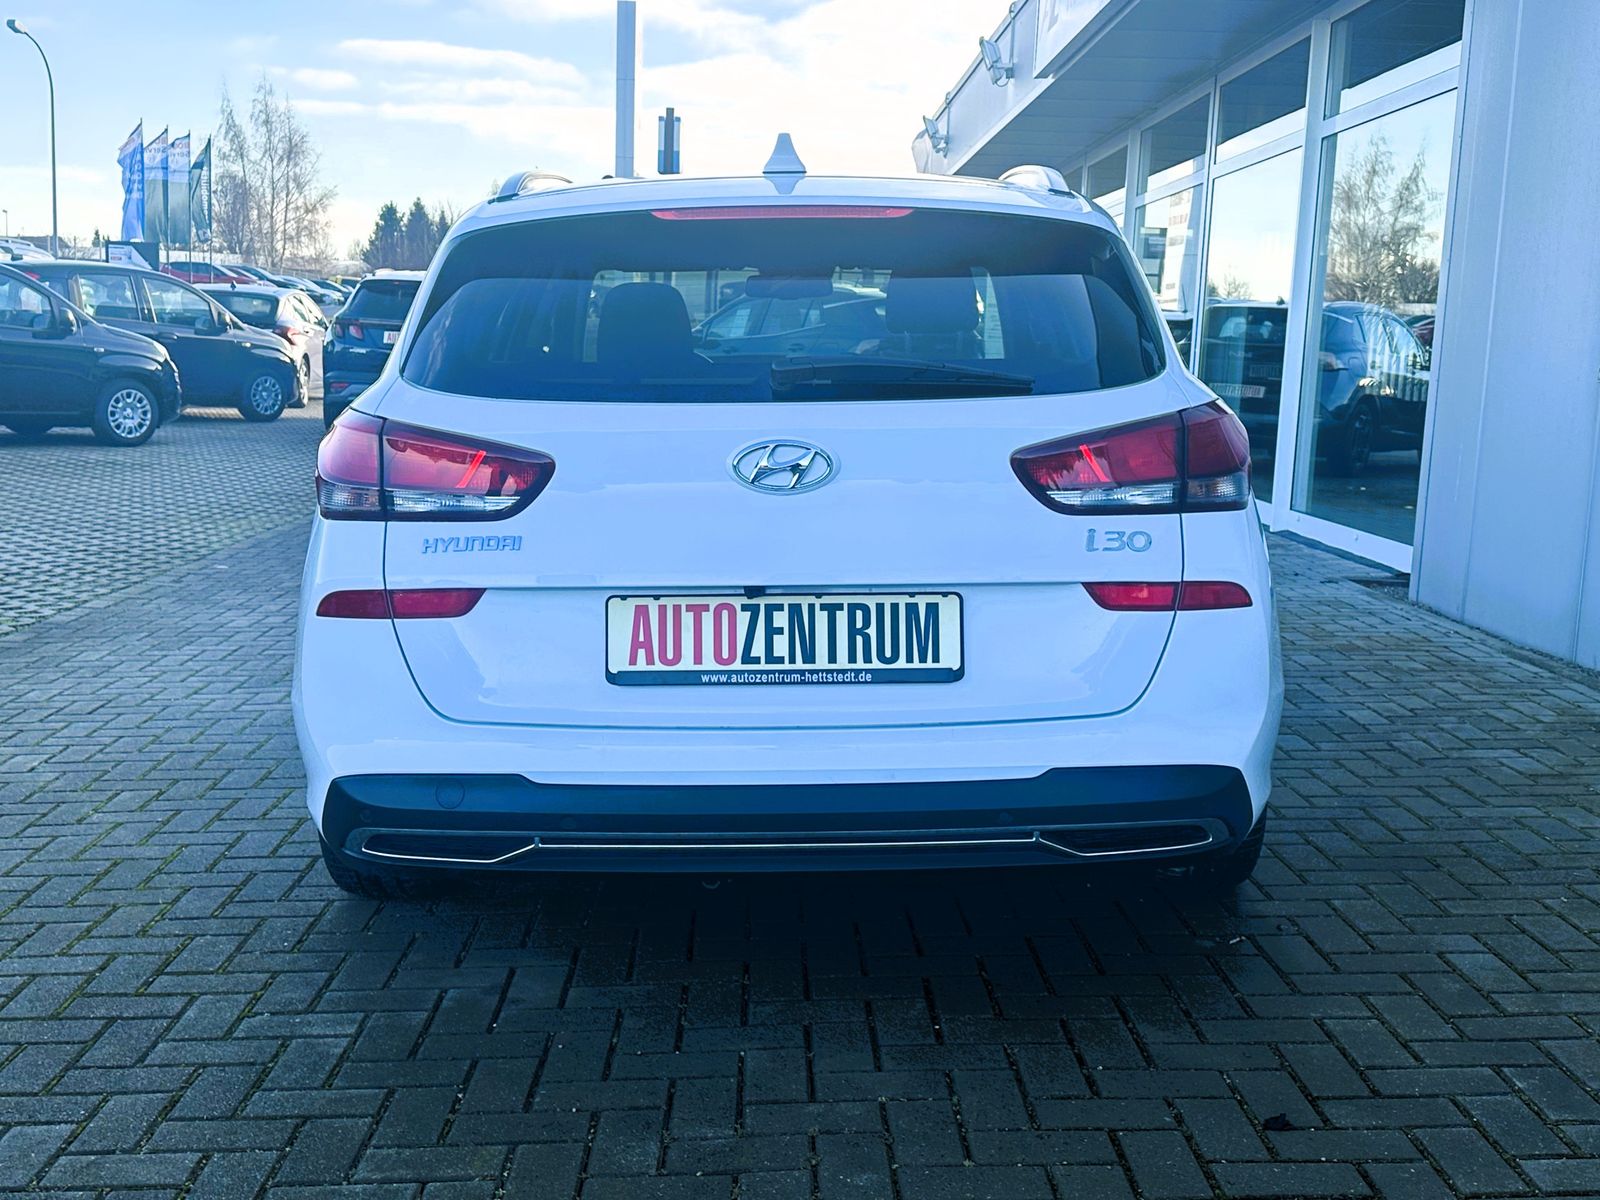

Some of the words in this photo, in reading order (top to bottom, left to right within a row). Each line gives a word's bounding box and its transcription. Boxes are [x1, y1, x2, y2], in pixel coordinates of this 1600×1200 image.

[422, 535, 522, 554] HYUNDAI
[1085, 528, 1152, 552] i30
[628, 602, 940, 667] AUTOZENTRUM
[701, 671, 872, 683] www.autozentrum-hettstedt.de
